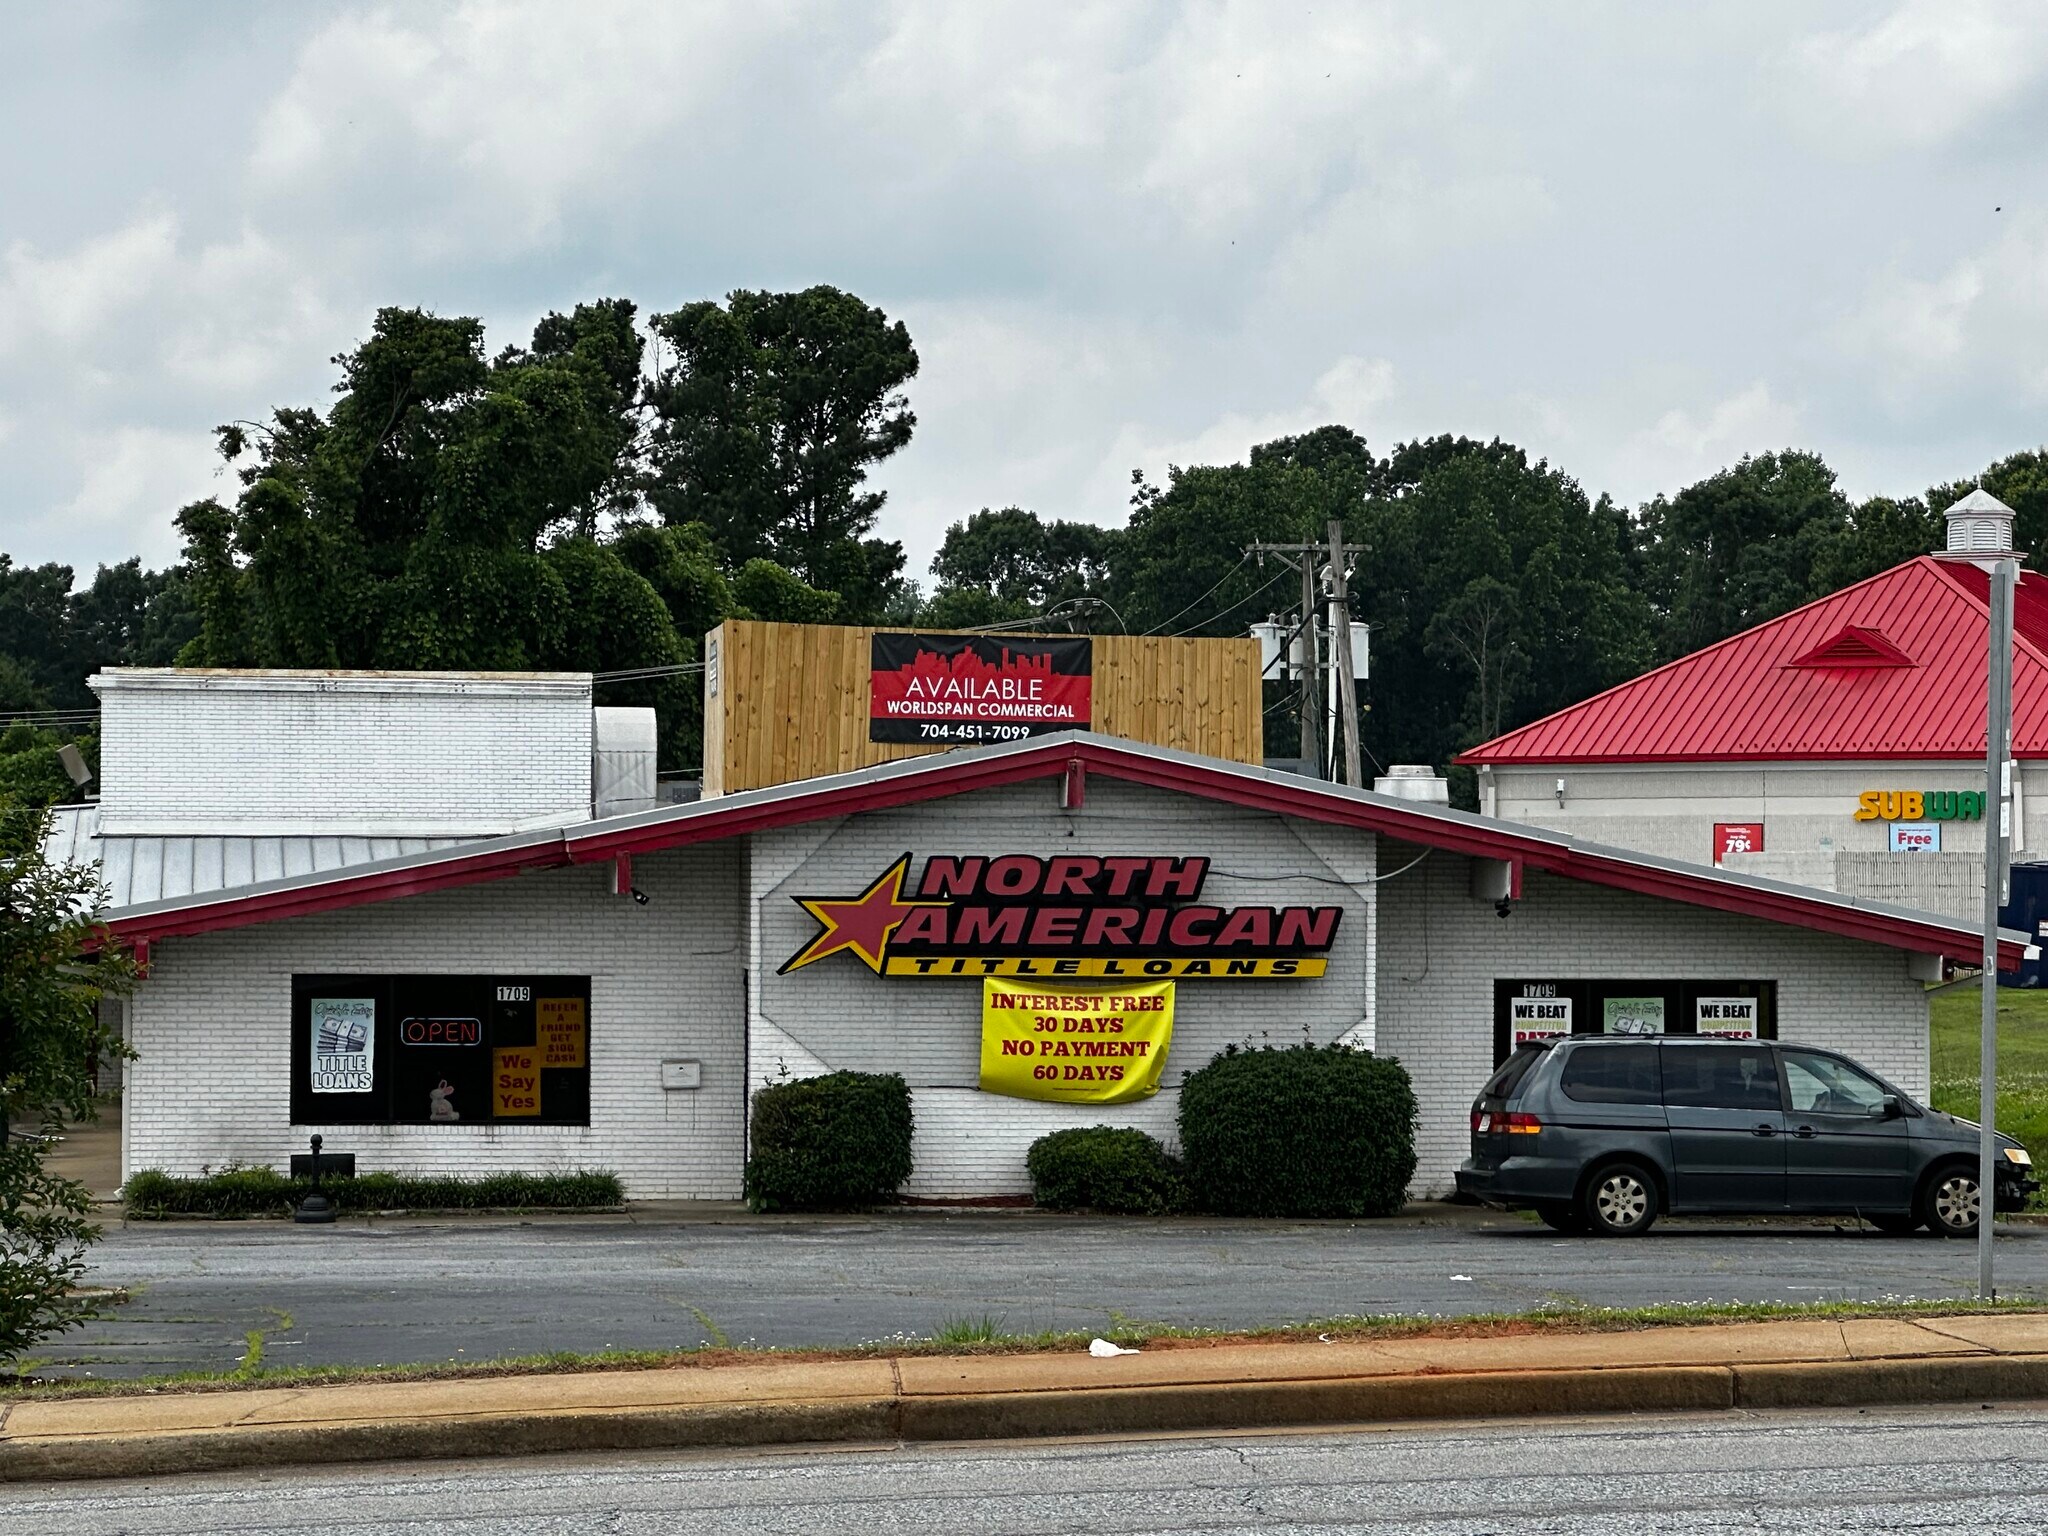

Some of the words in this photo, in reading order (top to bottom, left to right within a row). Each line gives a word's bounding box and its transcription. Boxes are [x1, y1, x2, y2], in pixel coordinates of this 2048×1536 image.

[905, 676, 1043, 700] AVAILABLE
[887, 700, 974, 716] WORLDSPAN
[977, 702, 1075, 718] COMMERCIAL
[920, 724, 1031, 740] 704-451-7099
[1854, 790, 1986, 822] SUBWA
[1725, 839, 1751, 853] 79¢
[1898, 832, 1932, 845] Free
[921, 857, 1205, 897] NORTH
[890, 907, 1337, 946] AMERICAN
[915, 959, 1082, 975] TITLE
[1104, 960, 1300, 976] LOANS
[498, 987, 529, 1001] 1709
[1524, 984, 1555, 998] 1709
[543, 1003, 578, 1012] REFER
[991, 993, 1104, 1012] INTEREST
[1109, 996, 1165, 1012] FREE
[557, 1013, 565, 1022] A
[1514, 1004, 1535, 1019] WE
[1537, 1004, 1567, 1019] BEAT
[1700, 1004, 1720, 1019] WE
[1722, 1004, 1752, 1019] BEAT
[407, 1022, 476, 1042] OPEN
[540, 1023, 581, 1033] FRIEND
[1033, 1016, 1058, 1033] 30
[1063, 1017, 1124, 1033] DAYS
[550, 1033, 572, 1042] GET
[1002, 1040, 1035, 1056] NO
[1040, 1041, 1151, 1057] PAYMENT
[318, 1055, 367, 1072] TITLE
[501, 1054, 532, 1069] We
[545, 1053, 577, 1063] CASH
[312, 1072, 372, 1089] LOANS
[1033, 1065, 1058, 1080] 60
[1063, 1066, 1124, 1081] DAYS
[498, 1074, 536, 1092] Say
[499, 1094, 535, 1108] Yes
